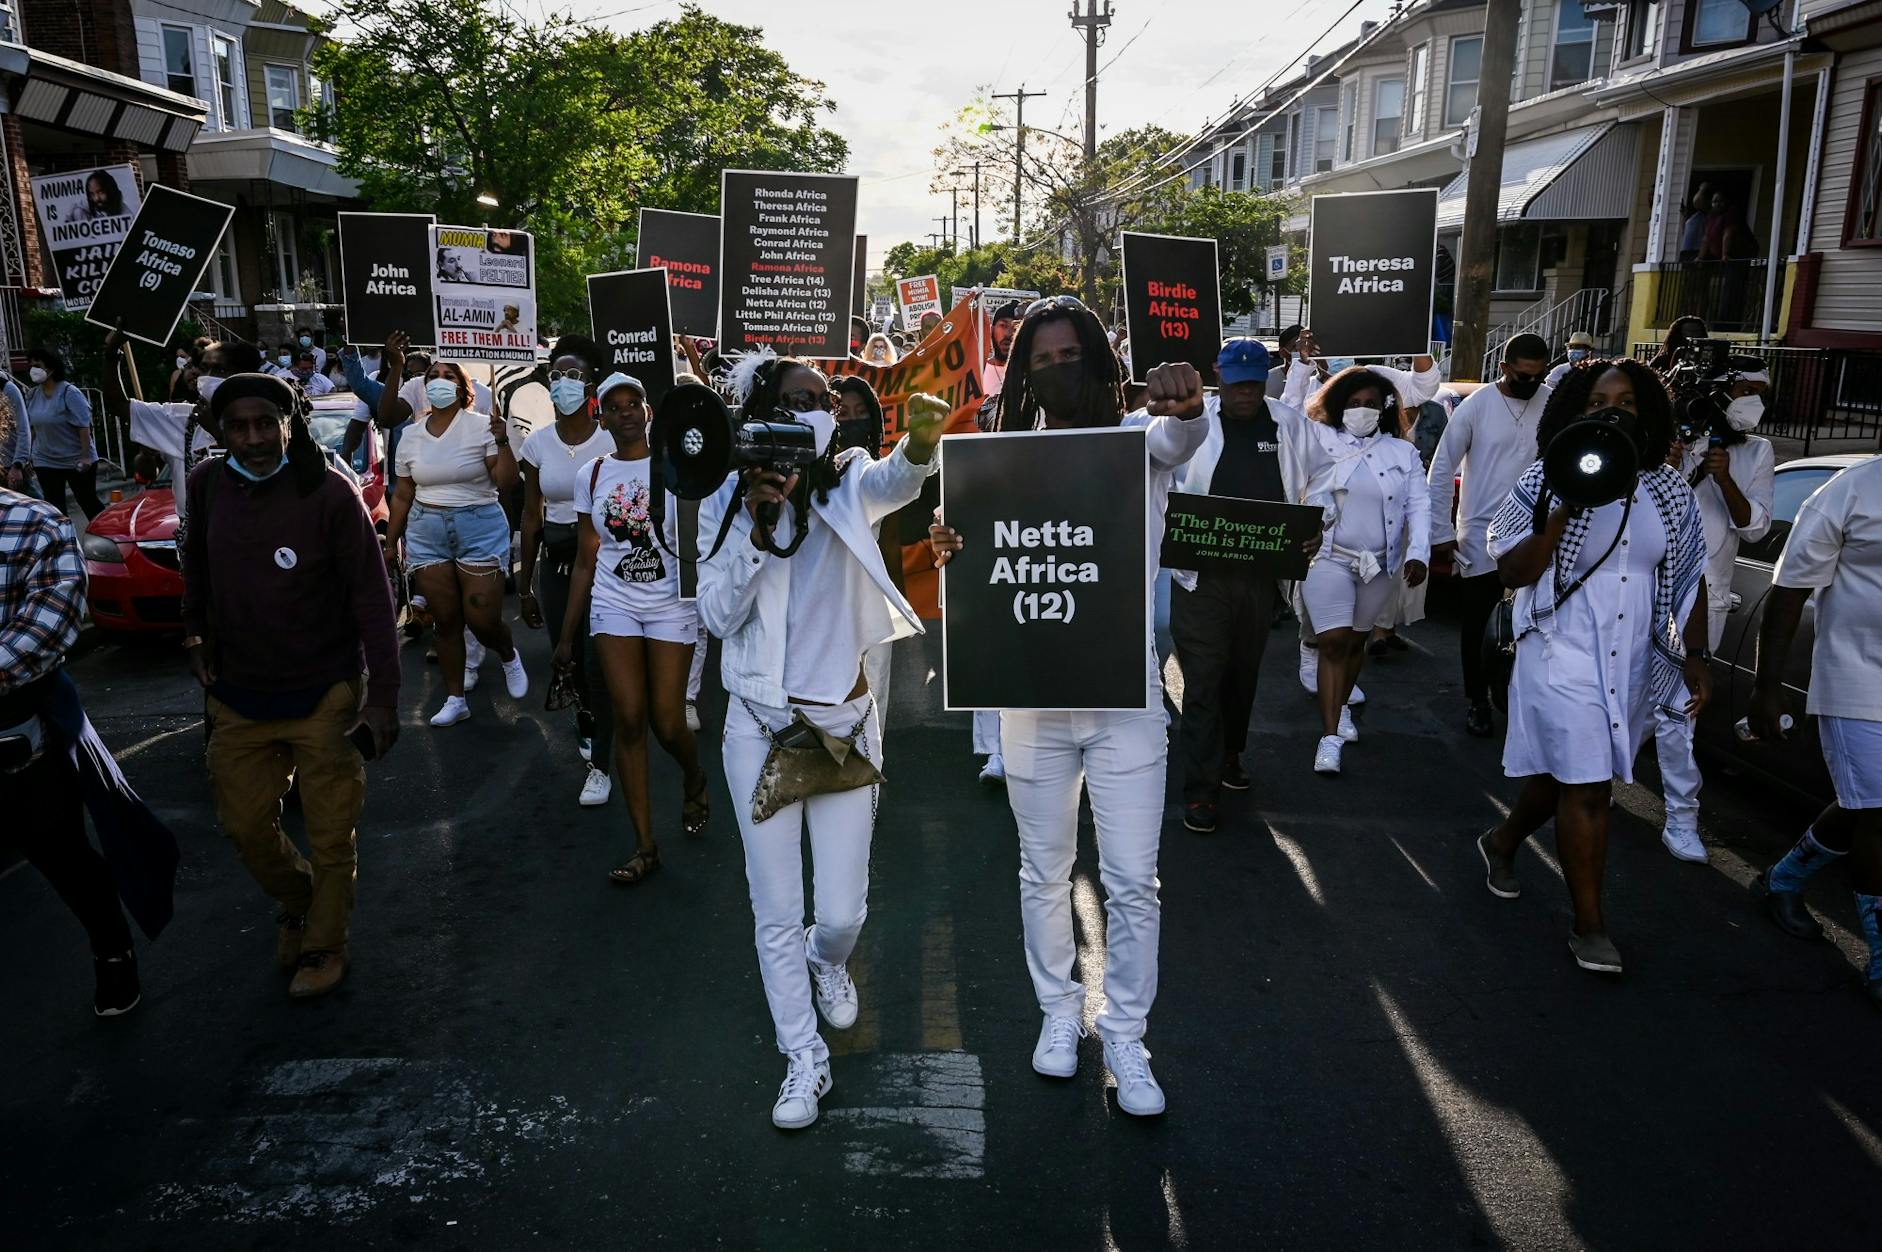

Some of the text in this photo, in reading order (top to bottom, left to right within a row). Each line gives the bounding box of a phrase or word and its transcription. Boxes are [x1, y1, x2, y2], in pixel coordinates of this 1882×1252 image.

[41, 179, 85, 200] MUMIA
[755, 188, 827, 200] Rhonda Africa
[46, 204, 58, 221] IS
[753, 201, 827, 212] Theresa Africa
[759, 214, 821, 224] Frank Africa
[52, 216, 132, 242] INNOCENT
[750, 226, 829, 237] Raymond Africa
[142, 230, 196, 259] Tomaso
[438, 231, 486, 249] MUMIA
[754, 238, 823, 249] Conrad Africa
[136, 250, 182, 276] Africa
[480, 255, 525, 269] Leonard
[760, 251, 816, 261] John Africa
[371, 263, 409, 278] John
[650, 255, 711, 274] Ramona
[752, 263, 824, 273] Ramona Africa
[1329, 256, 1415, 273] Theresa
[140, 270, 162, 291] (9)
[480, 269, 525, 284] PELTIER
[668, 273, 702, 289] frica
[749, 274, 825, 286] Tree Africa (14)
[366, 280, 417, 296] Africa
[742, 286, 832, 298] Delisha Africa (13)
[1148, 281, 1197, 300] Birdie
[1337, 275, 1404, 295] Africa
[746, 299, 827, 310] Netta Africa (12)
[1148, 301, 1199, 319] Africa
[443, 308, 495, 324] AL-AMIN
[735, 310, 836, 322] Little Phil Africa (12)
[607, 326, 657, 345] Conrad
[743, 323, 828, 333] Tomaso Africa (9)
[1160, 320, 1190, 340] (13)
[441, 331, 530, 347] FREE THEM ALL!
[744, 334, 826, 345] Birdie Africa (13)
[440, 348, 533, 361] MOBILIZATION4MUMIA
[613, 347, 656, 364] Africa
[1170, 511, 1287, 537] “The Power of
[994, 520, 1094, 548] Netta
[1170, 527, 1217, 546] Truth
[1222, 534, 1235, 548] is
[1195, 549, 1255, 561] JOHN AFRICA
[621, 556, 660, 572] Equality
[989, 555, 1099, 585] Africa
[1013, 589, 1076, 625] (12)
